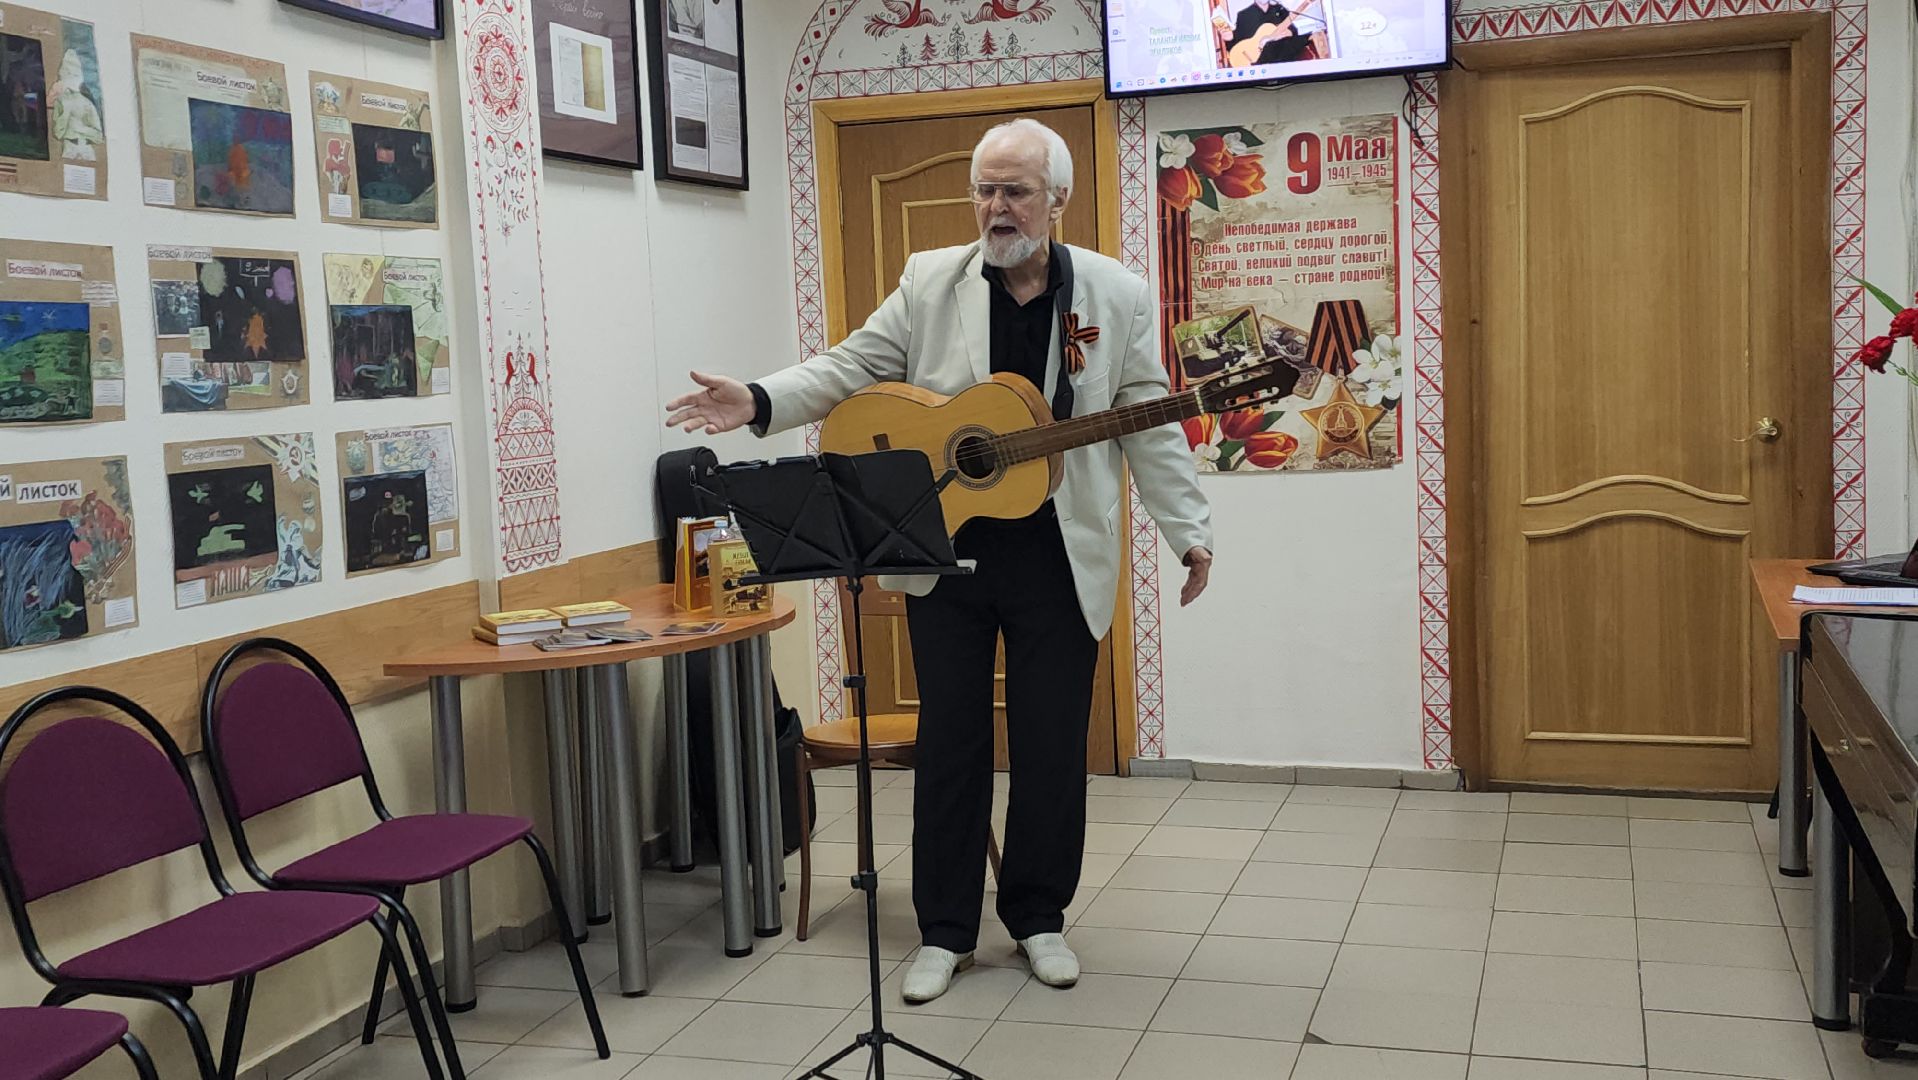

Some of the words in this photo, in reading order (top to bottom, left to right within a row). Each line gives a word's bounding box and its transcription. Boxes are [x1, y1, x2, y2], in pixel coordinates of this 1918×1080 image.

[196, 70, 228, 87] Боевой
[229, 79, 257, 91] листок
[361, 95, 386, 108] Боевой
[1287, 132, 1322, 195] 9
[1327, 134, 1387, 163] Мая
[1224, 221, 1301, 236] Непобедимая
[1306, 217, 1357, 233] держава
[147, 247, 180, 260] Боевой
[183, 251, 211, 260] листок
[1193, 244, 1201, 256] В
[1204, 243, 1231, 256] день
[1294, 236, 1334, 250] сердцу
[1246, 253, 1292, 270] великий
[1297, 254, 1335, 268] подвиг
[1342, 249, 1388, 264] славит!
[7, 262, 47, 276] Боевой
[48, 267, 82, 278] листок
[383, 271, 406, 281] Боевой
[1200, 275, 1224, 290] Мир
[1228, 275, 1242, 288] на
[1246, 274, 1273, 286] века
[1294, 269, 1335, 284] стране
[1340, 266, 1386, 283] родной!
[364, 431, 390, 441] Боевой
